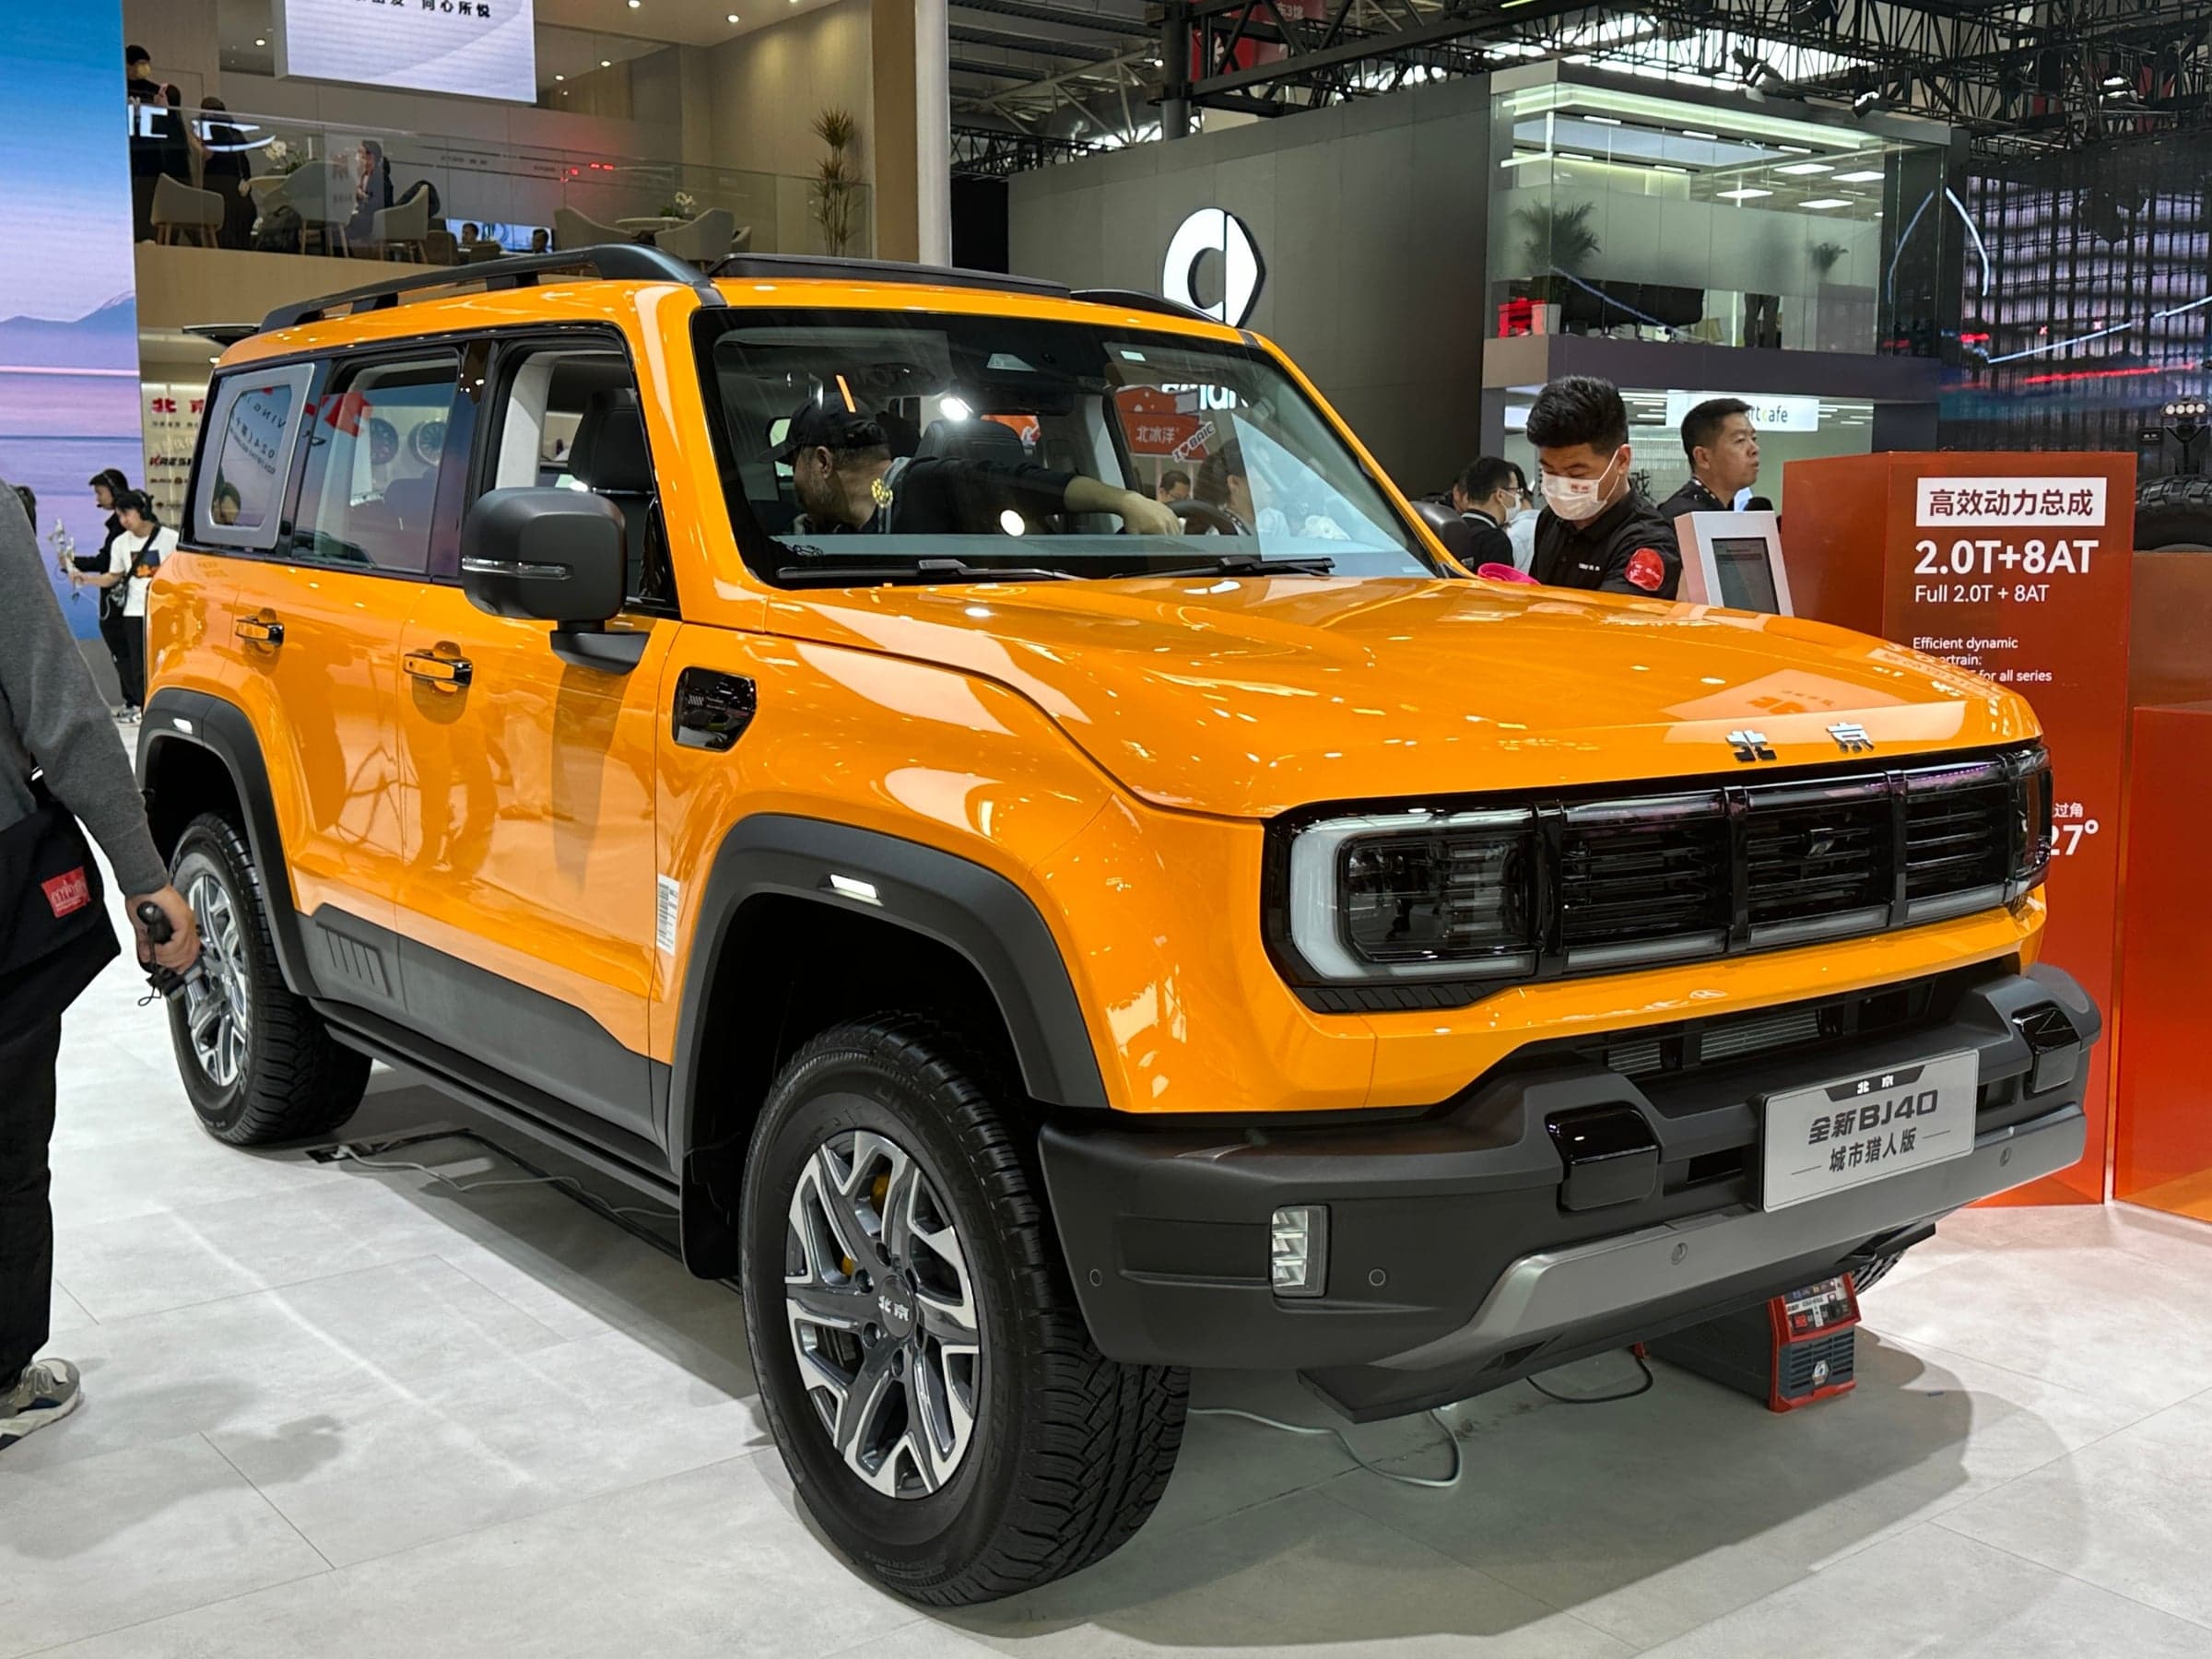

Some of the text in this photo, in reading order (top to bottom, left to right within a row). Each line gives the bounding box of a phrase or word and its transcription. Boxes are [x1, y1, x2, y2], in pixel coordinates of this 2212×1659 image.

[1136, 425, 1175, 443] 北冰洋
[1929, 489, 2093, 516] 高效动力总成
[1914, 540, 2099, 574] 2.0T+8AT
[1915, 585, 1947, 602] Full
[1953, 585, 1994, 602] 2.0T
[2014, 585, 2050, 602] 8AT
[1913, 637, 2018, 652] Efficient dynamic
[1999, 670, 2013, 681] all
[2017, 671, 2053, 681] series
[1726, 723, 1875, 762] 北京
[1856, 1075, 1894, 1095] 北京
[1807, 1089, 1938, 1146] 全新BJ40
[1829, 1127, 1917, 1173] 城市猎人版
[877, 1296, 909, 1322] 北京
